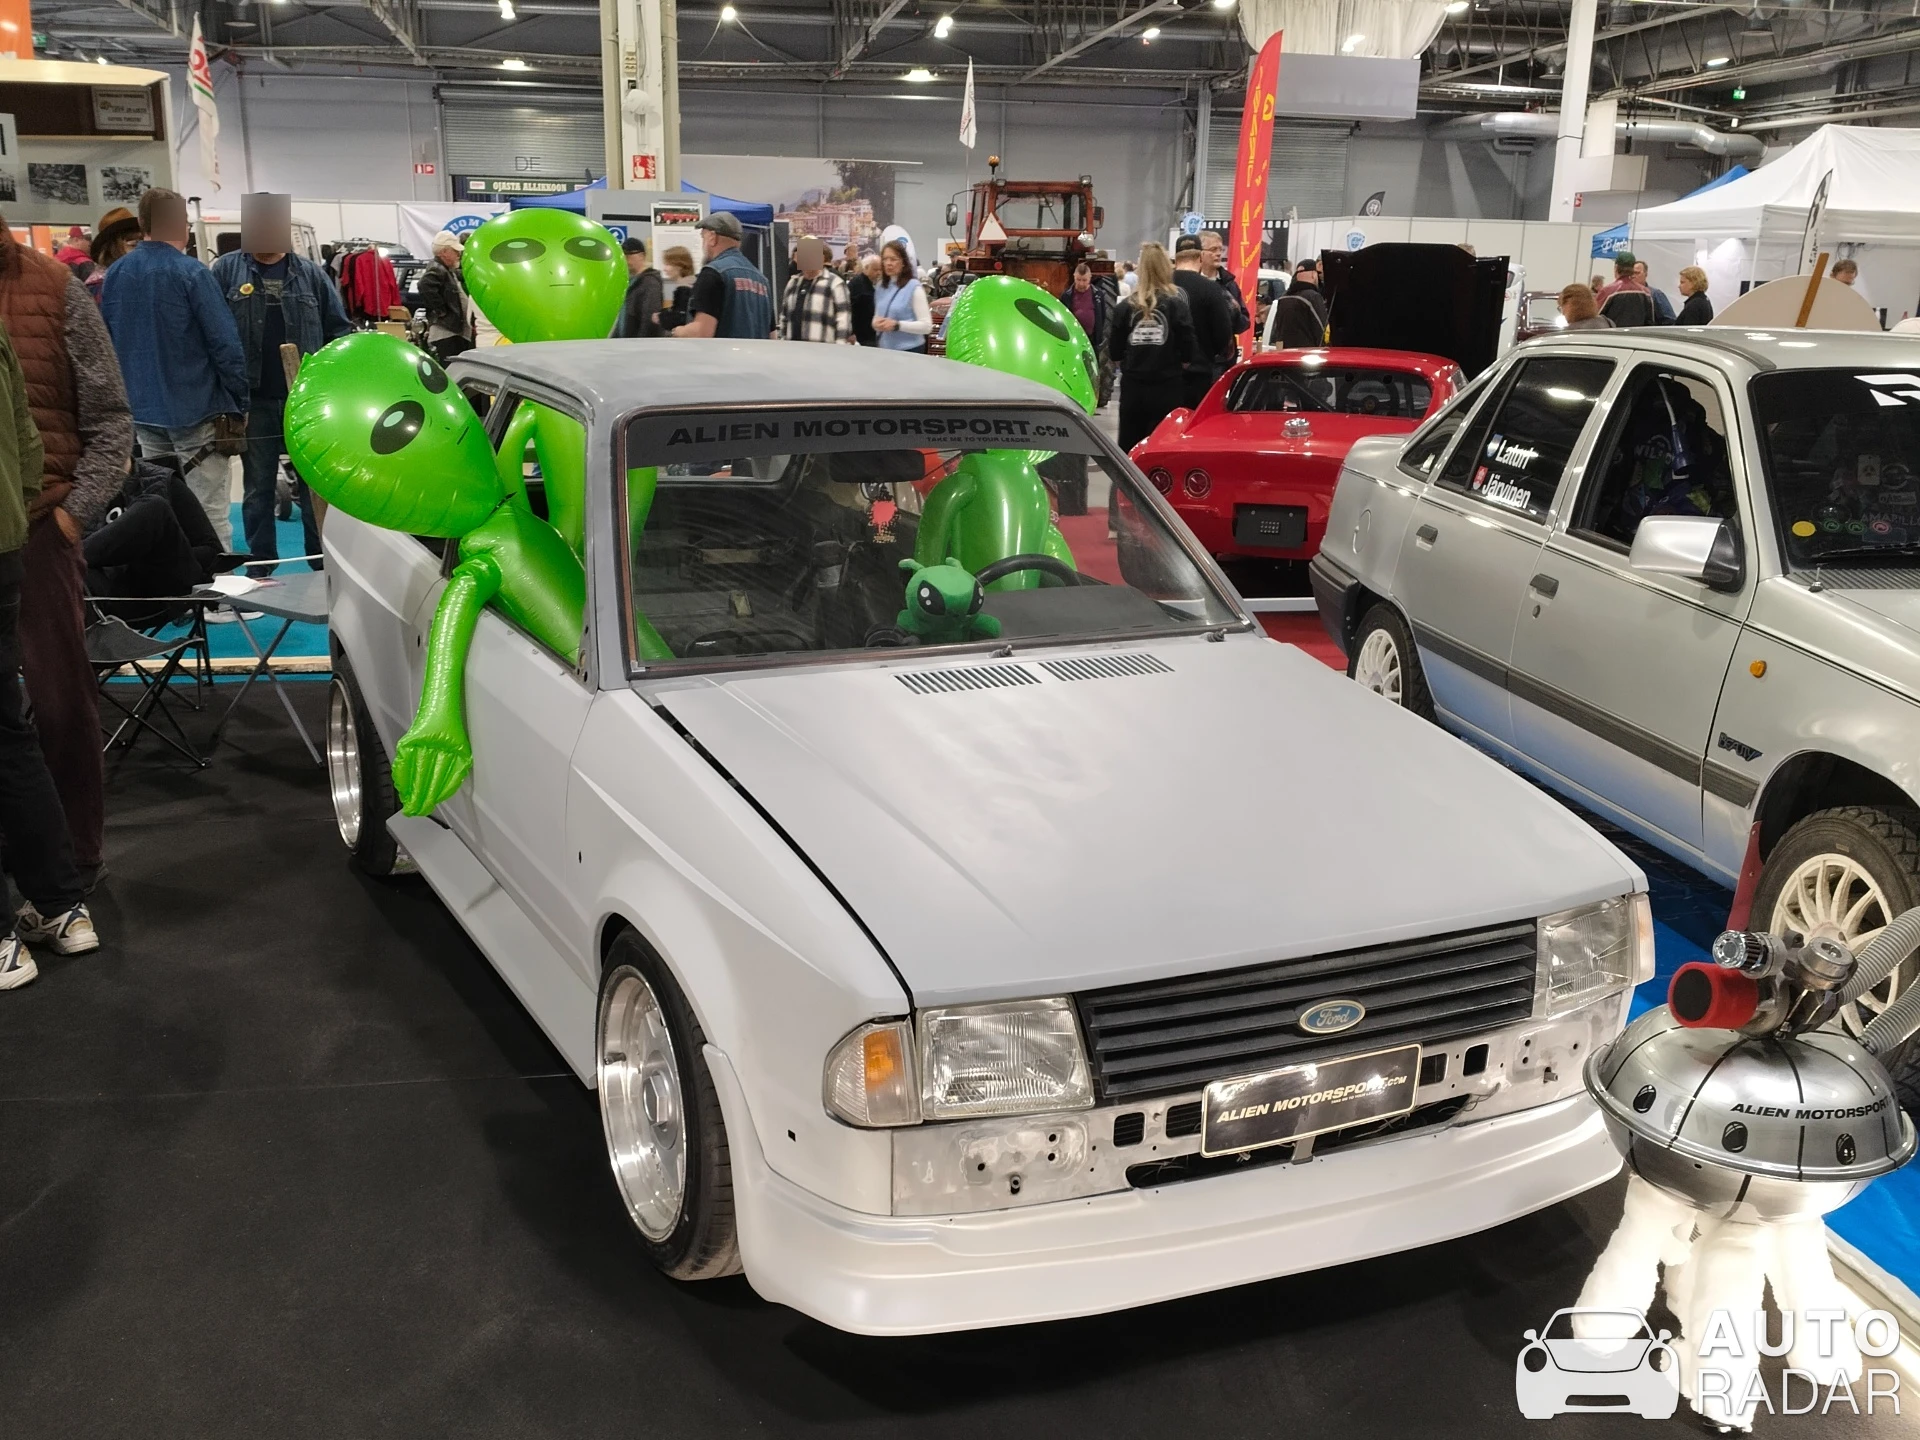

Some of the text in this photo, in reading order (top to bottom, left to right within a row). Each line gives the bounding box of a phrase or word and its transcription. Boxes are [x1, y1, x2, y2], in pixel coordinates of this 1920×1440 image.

[515, 156, 541, 172] DE
[448, 218, 485, 231] UOM
[667, 422, 779, 446] ALIEN
[1482, 473, 1532, 509] Järvinen
[1316, 1007, 1351, 1027] Ford
[1217, 1103, 1270, 1123] ALIEN
[1731, 1096, 1889, 1120] ALIEN MOTORSPORT
